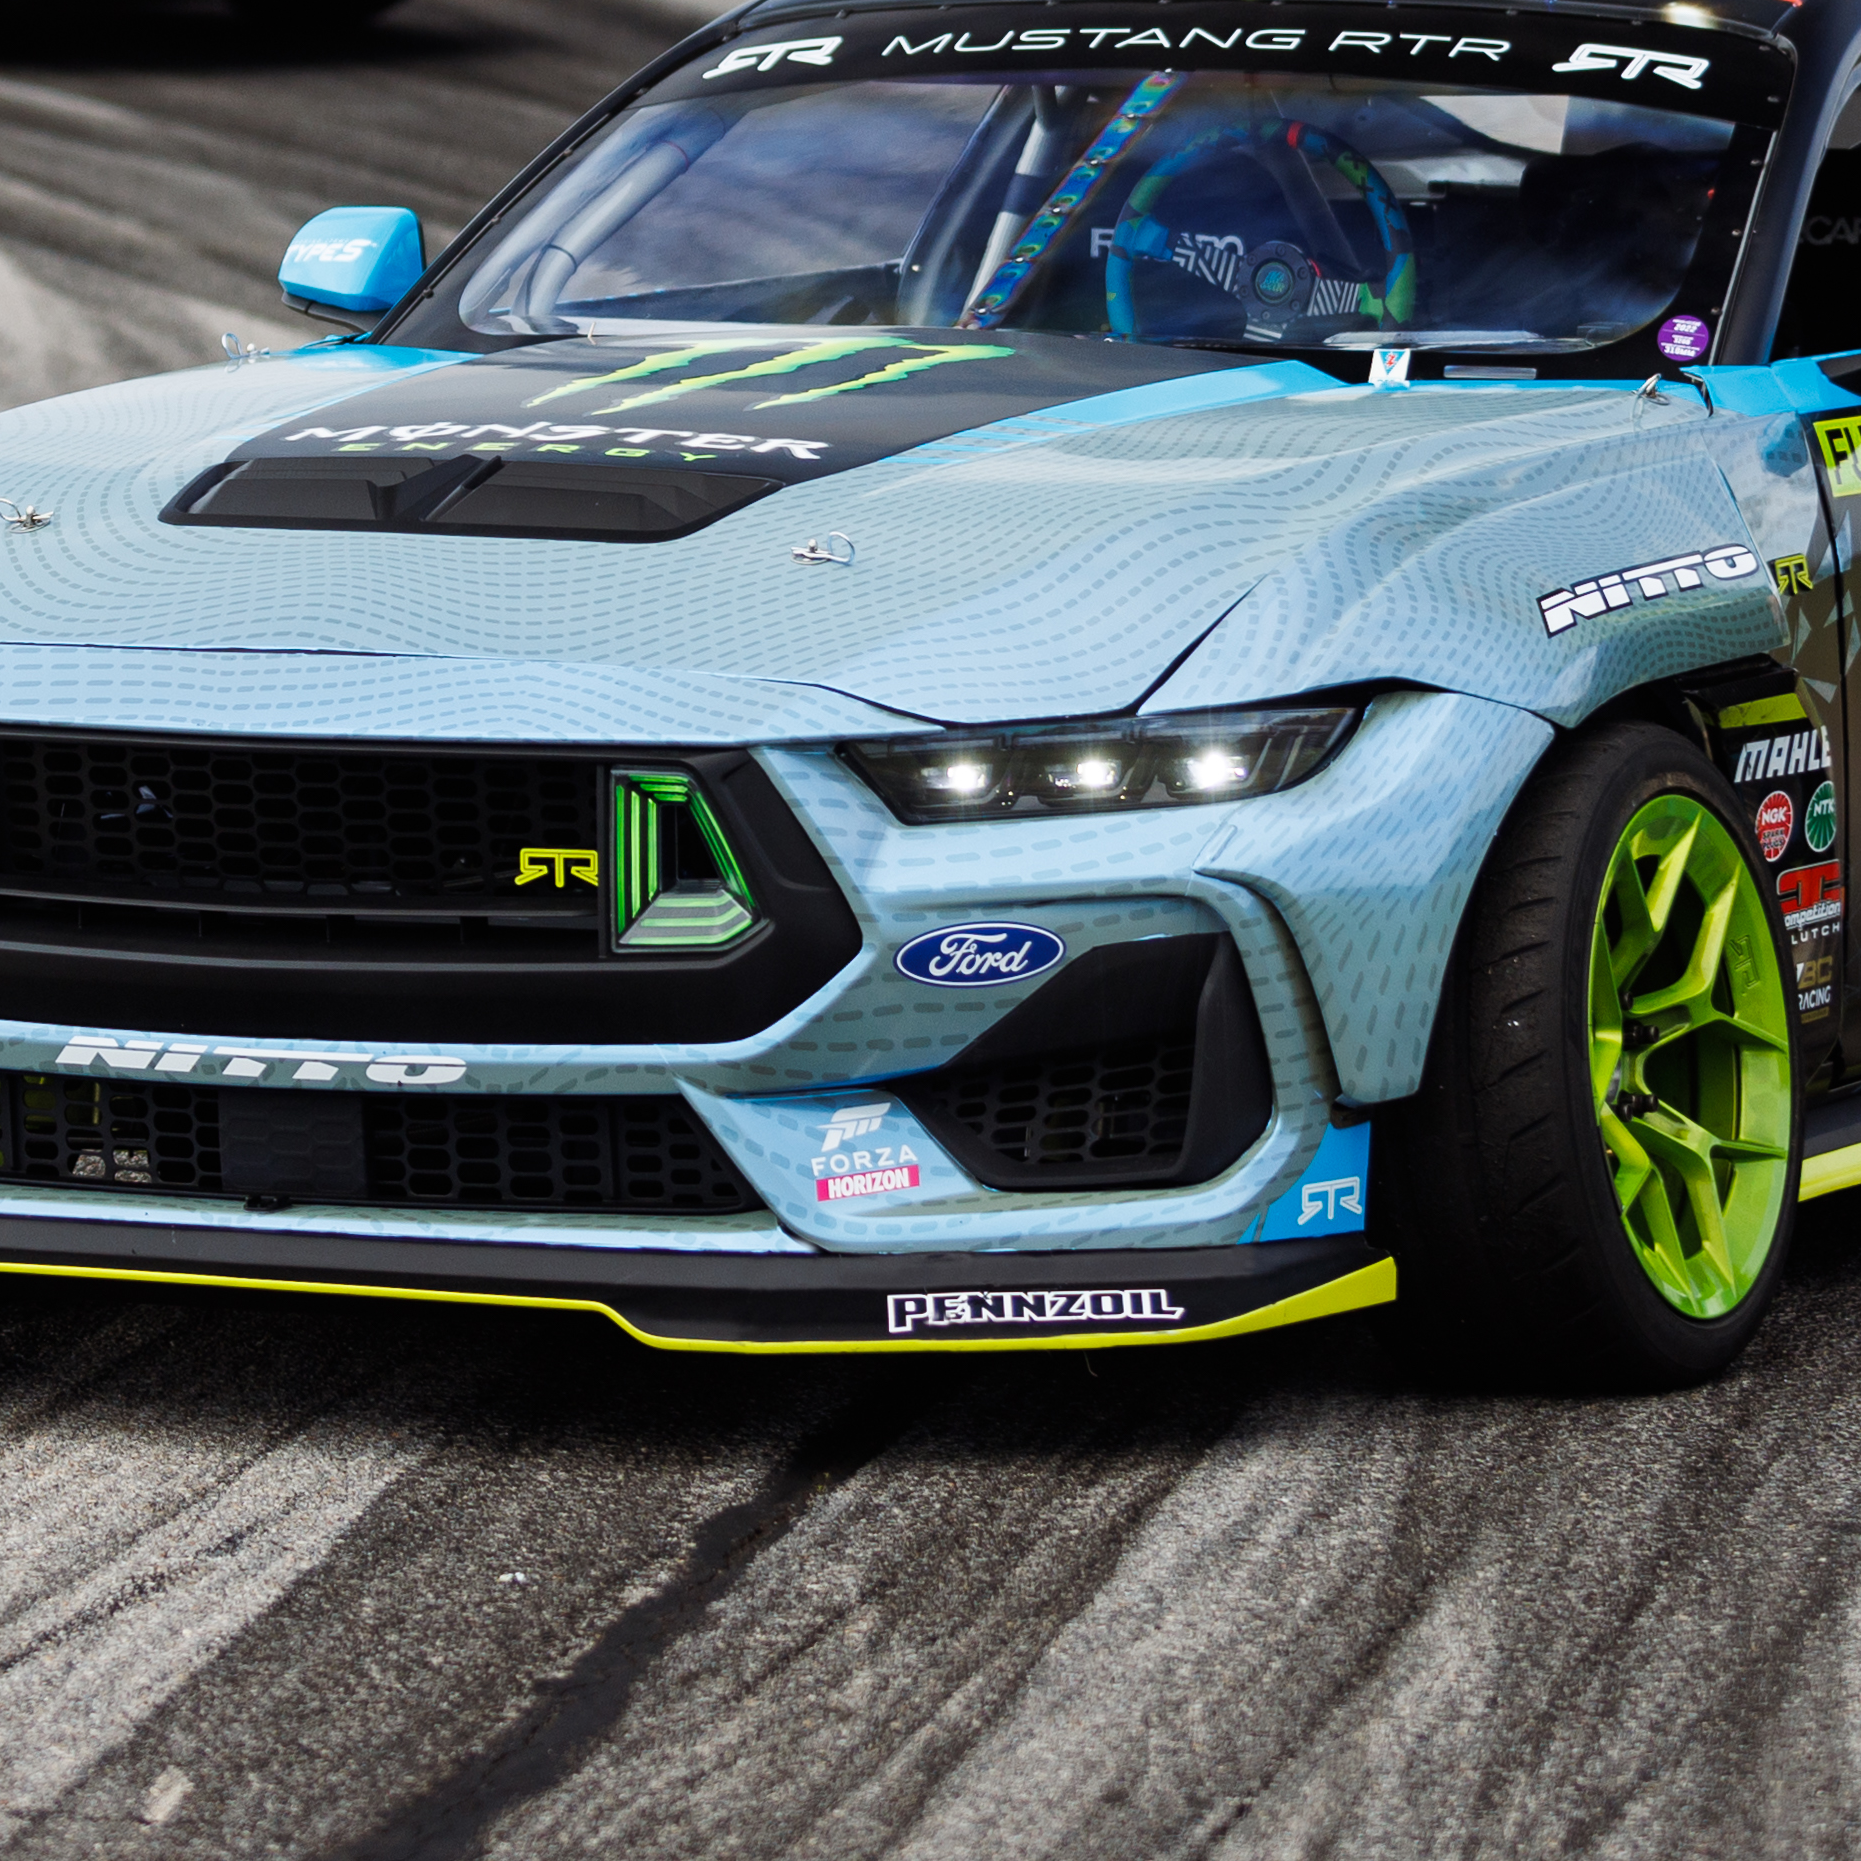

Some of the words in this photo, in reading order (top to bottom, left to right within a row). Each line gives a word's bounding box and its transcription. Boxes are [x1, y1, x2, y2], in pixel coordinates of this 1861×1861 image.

[881, 26, 1306, 57] MUSTANG
[1328, 29, 1512, 61] RTR
[284, 420, 833, 460] MONSTER
[339, 440, 718, 461] ENERGY
[1536, 542, 1760, 639] NITTO
[1734, 724, 1833, 784] MAHLE
[1761, 806, 1787, 826] NGK
[1813, 797, 1836, 817] NTK
[1784, 901, 1841, 931] ompetition
[1791, 922, 1841, 945] LUTCH
[927, 930, 1031, 981] Ford
[1797, 985, 1832, 1011] RACING
[55, 1034, 470, 1086] NITTO
[810, 1144, 918, 1177] FORZA
[827, 1167, 911, 1200] HORIZON
[886, 1289, 1185, 1333] PENNZOIL
